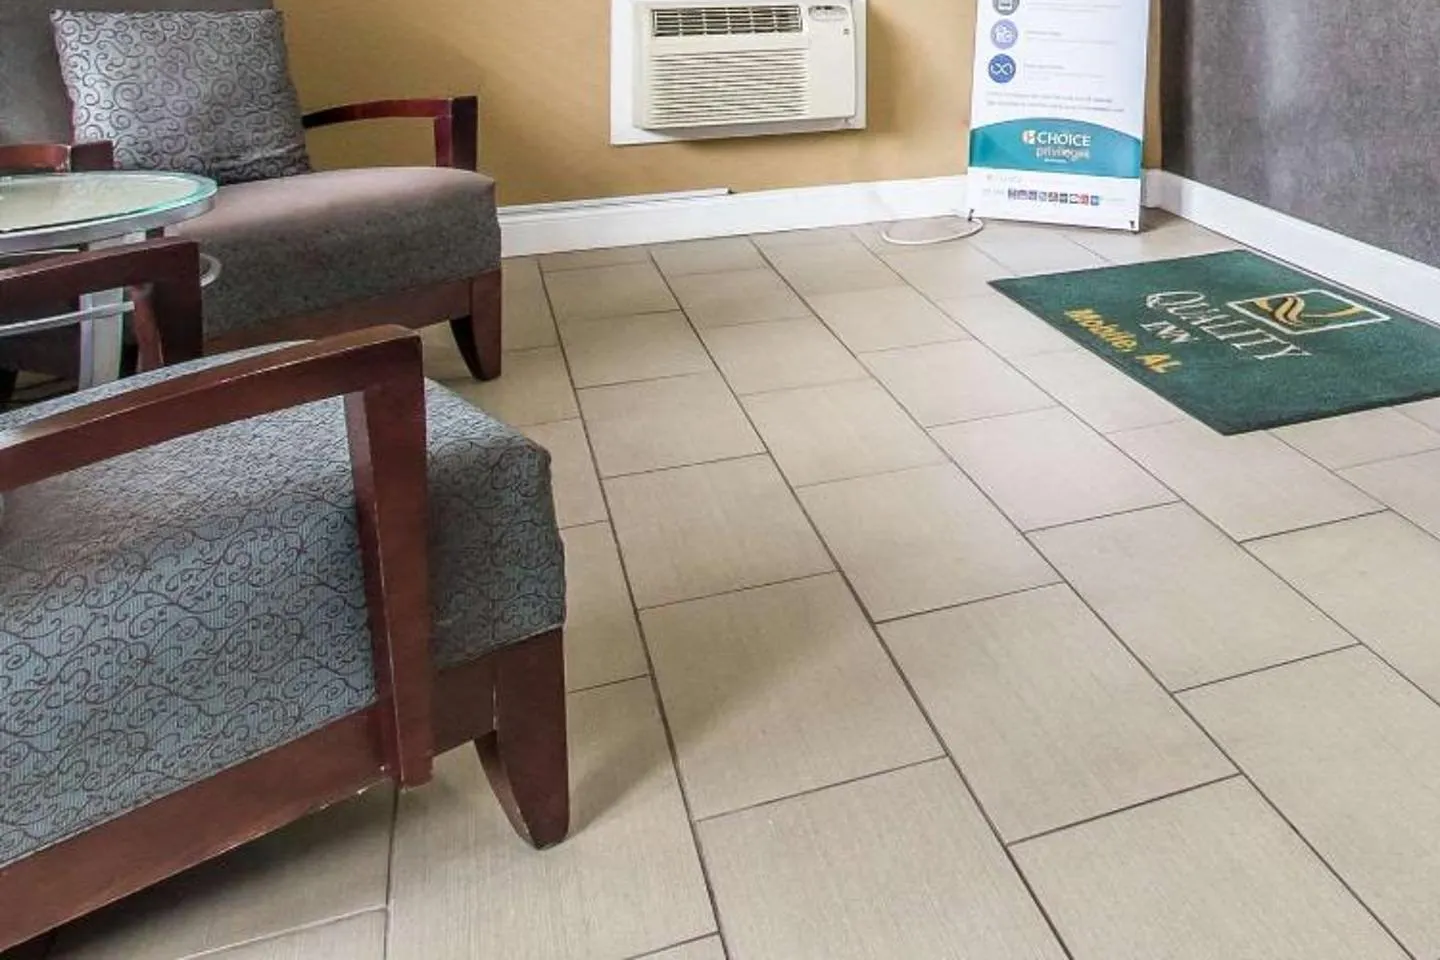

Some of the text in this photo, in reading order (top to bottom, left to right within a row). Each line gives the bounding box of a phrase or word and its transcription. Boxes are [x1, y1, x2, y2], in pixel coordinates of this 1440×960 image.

[1037, 131, 1092, 147] CHOICE
[1140, 320, 1200, 345] INN
[1145, 290, 1313, 361] QUALITY
[1134, 352, 1184, 374] AL
